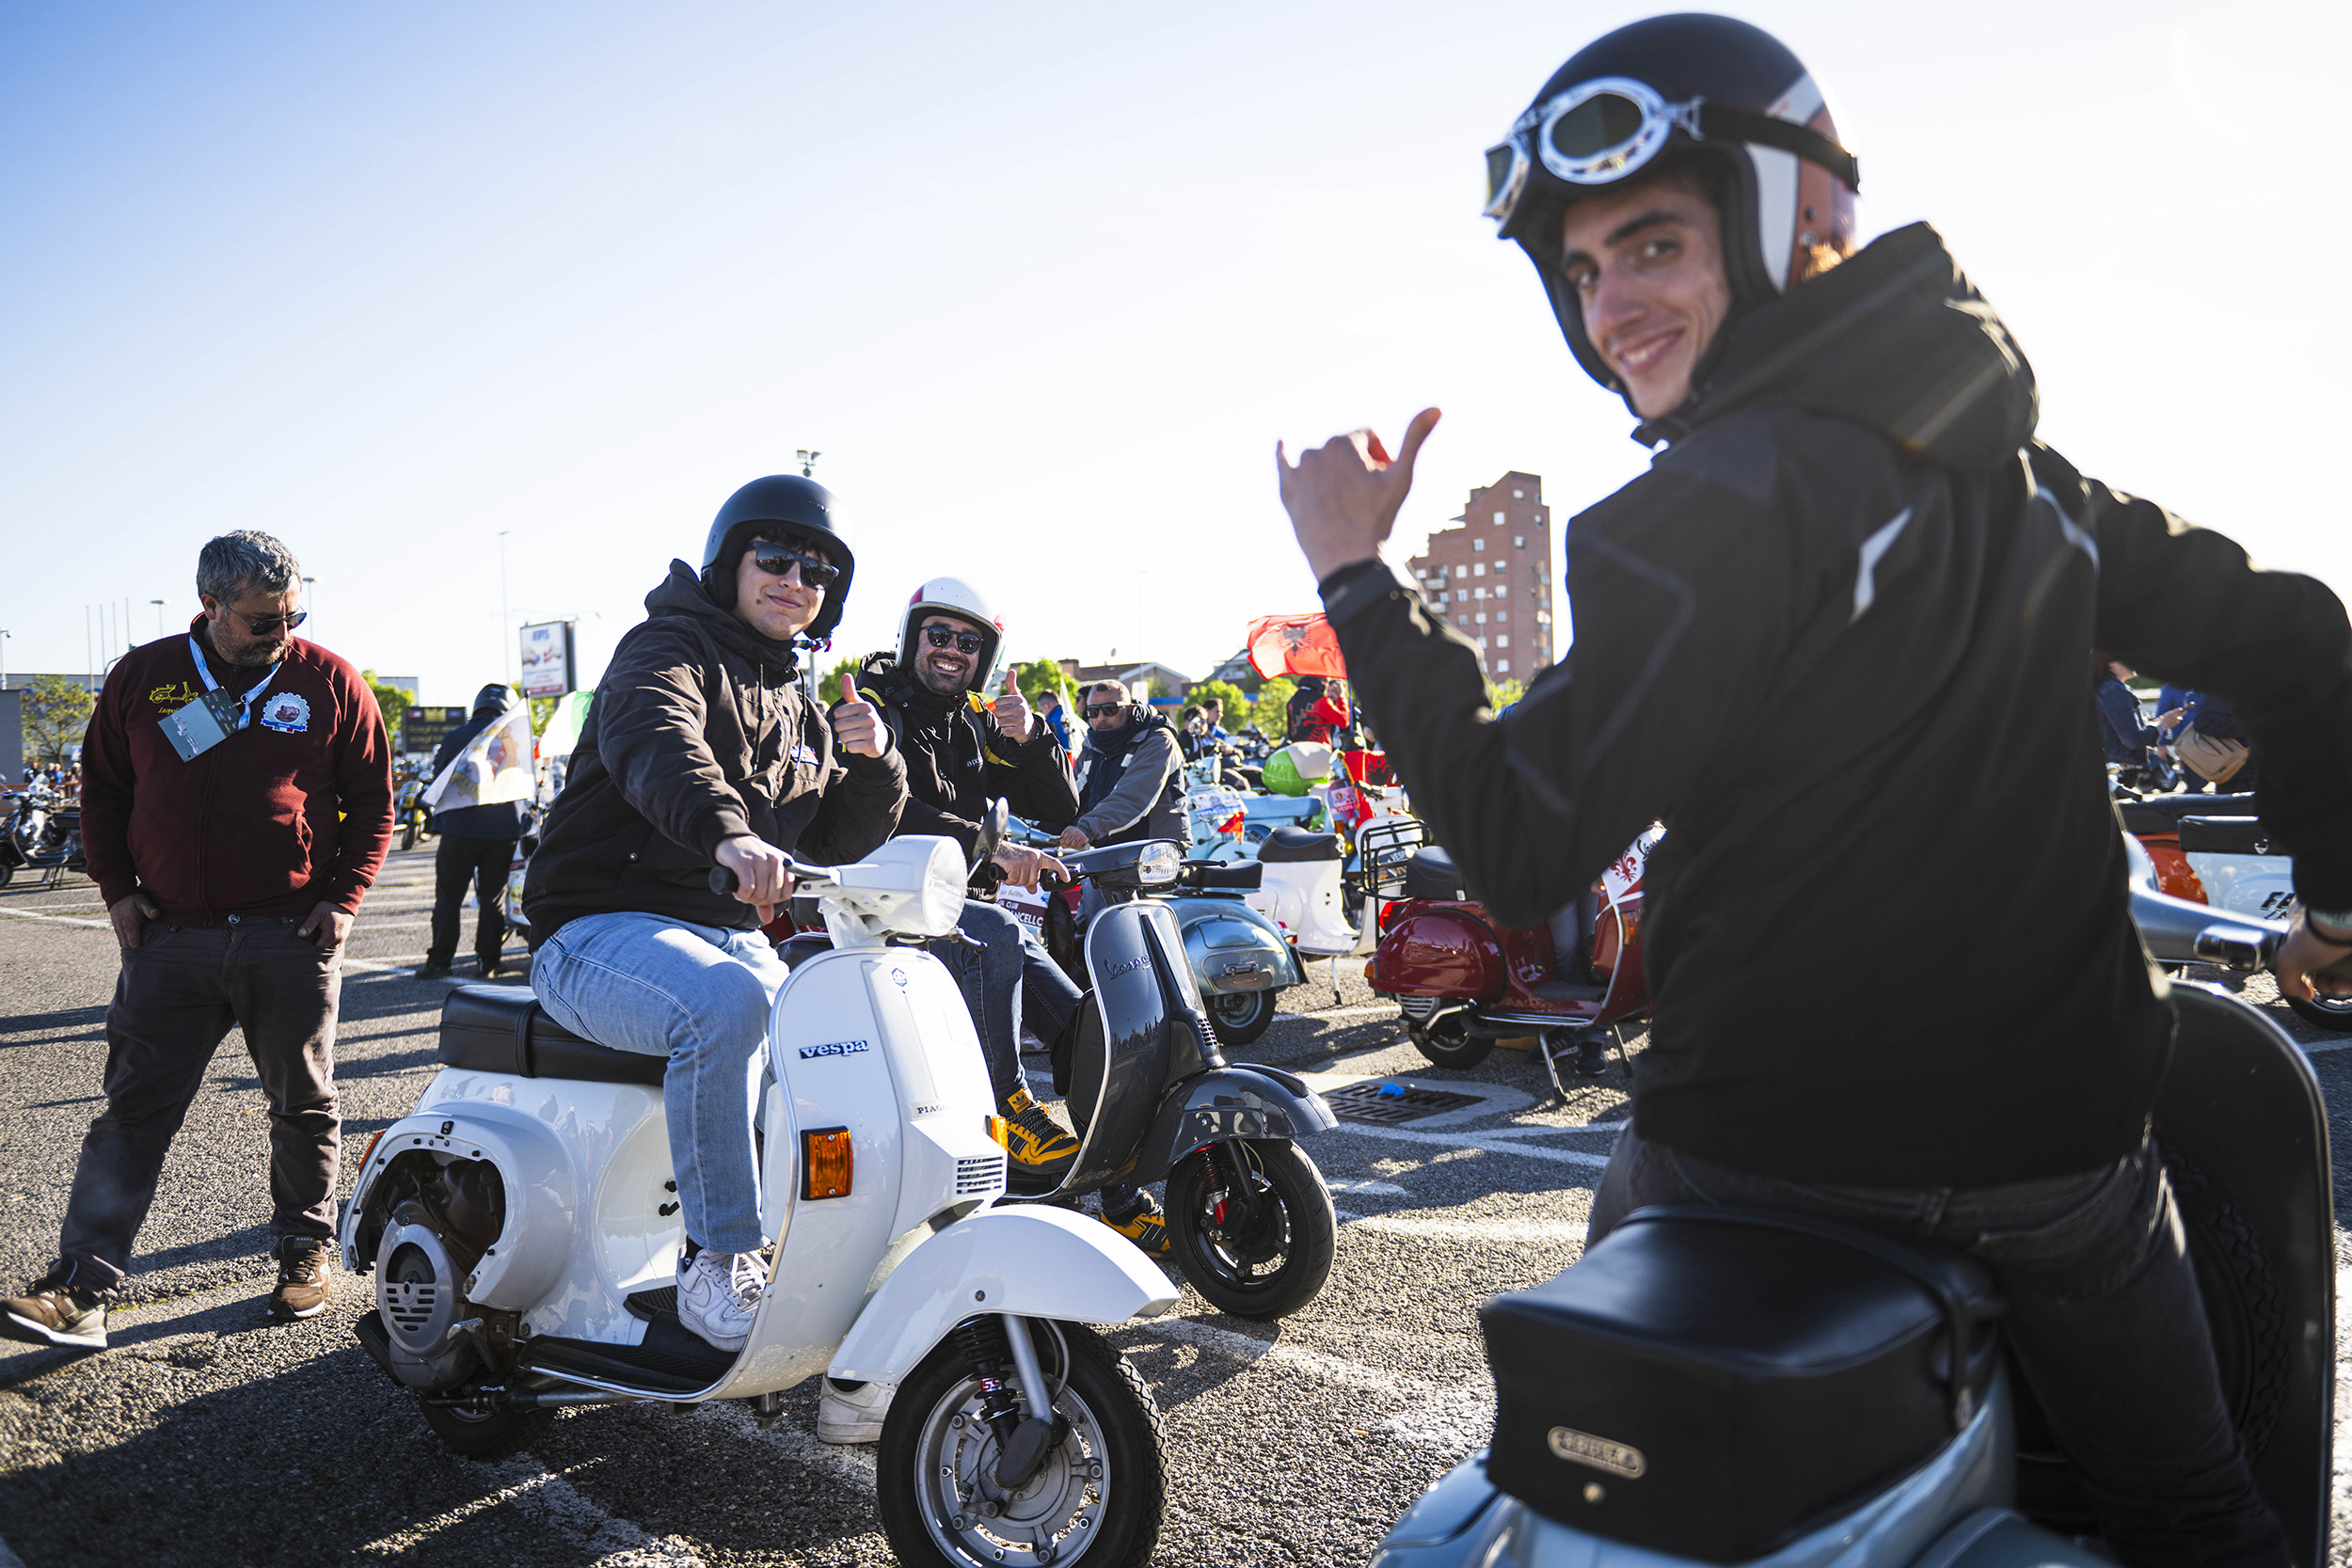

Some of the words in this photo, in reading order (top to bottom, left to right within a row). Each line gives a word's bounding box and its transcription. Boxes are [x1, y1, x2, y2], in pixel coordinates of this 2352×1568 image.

[1006, 901, 1019, 910] CLUB
[1104, 956, 1150, 980] Vespa
[800, 1040, 868, 1057] vespa
